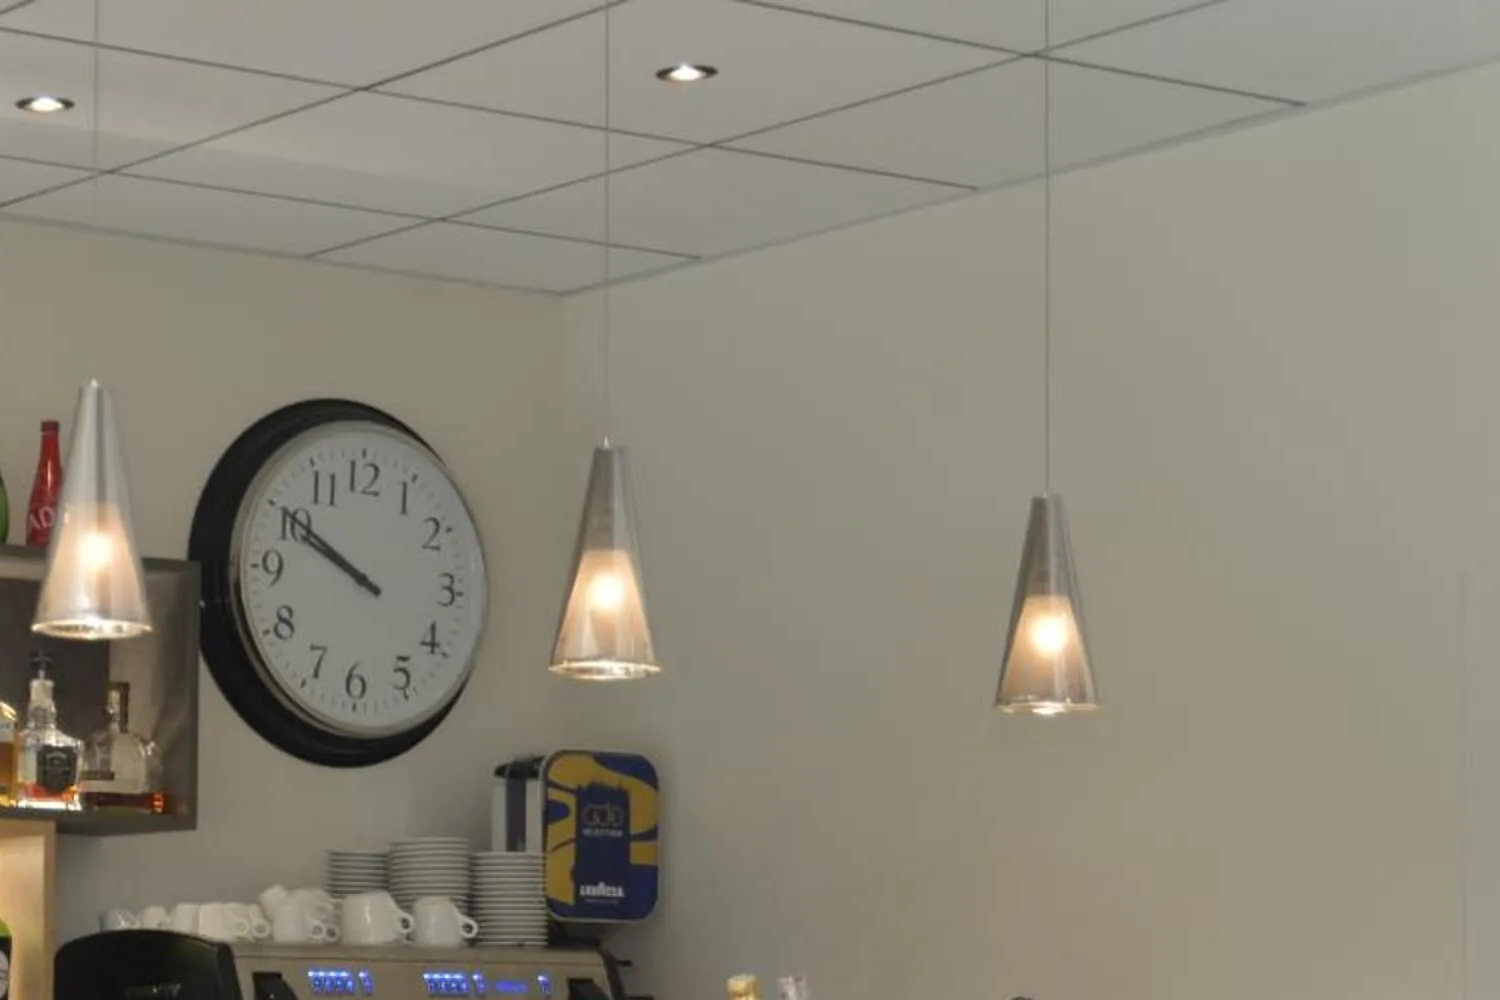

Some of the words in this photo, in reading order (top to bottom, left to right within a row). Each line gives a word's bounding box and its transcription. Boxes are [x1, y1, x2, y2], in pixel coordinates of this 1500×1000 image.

[311, 469, 336, 507] 11
[349, 459, 380, 496] 12
[399, 480, 409, 516] 1
[279, 504, 312, 542] 10
[421, 516, 442, 552] 2
[261, 549, 285, 588] 9
[436, 573, 457, 608] 3
[273, 605, 296, 641] 8
[419, 620, 441, 656] 4
[308, 644, 328, 680] 7
[392, 655, 412, 691] 5
[344, 662, 368, 701] 6
